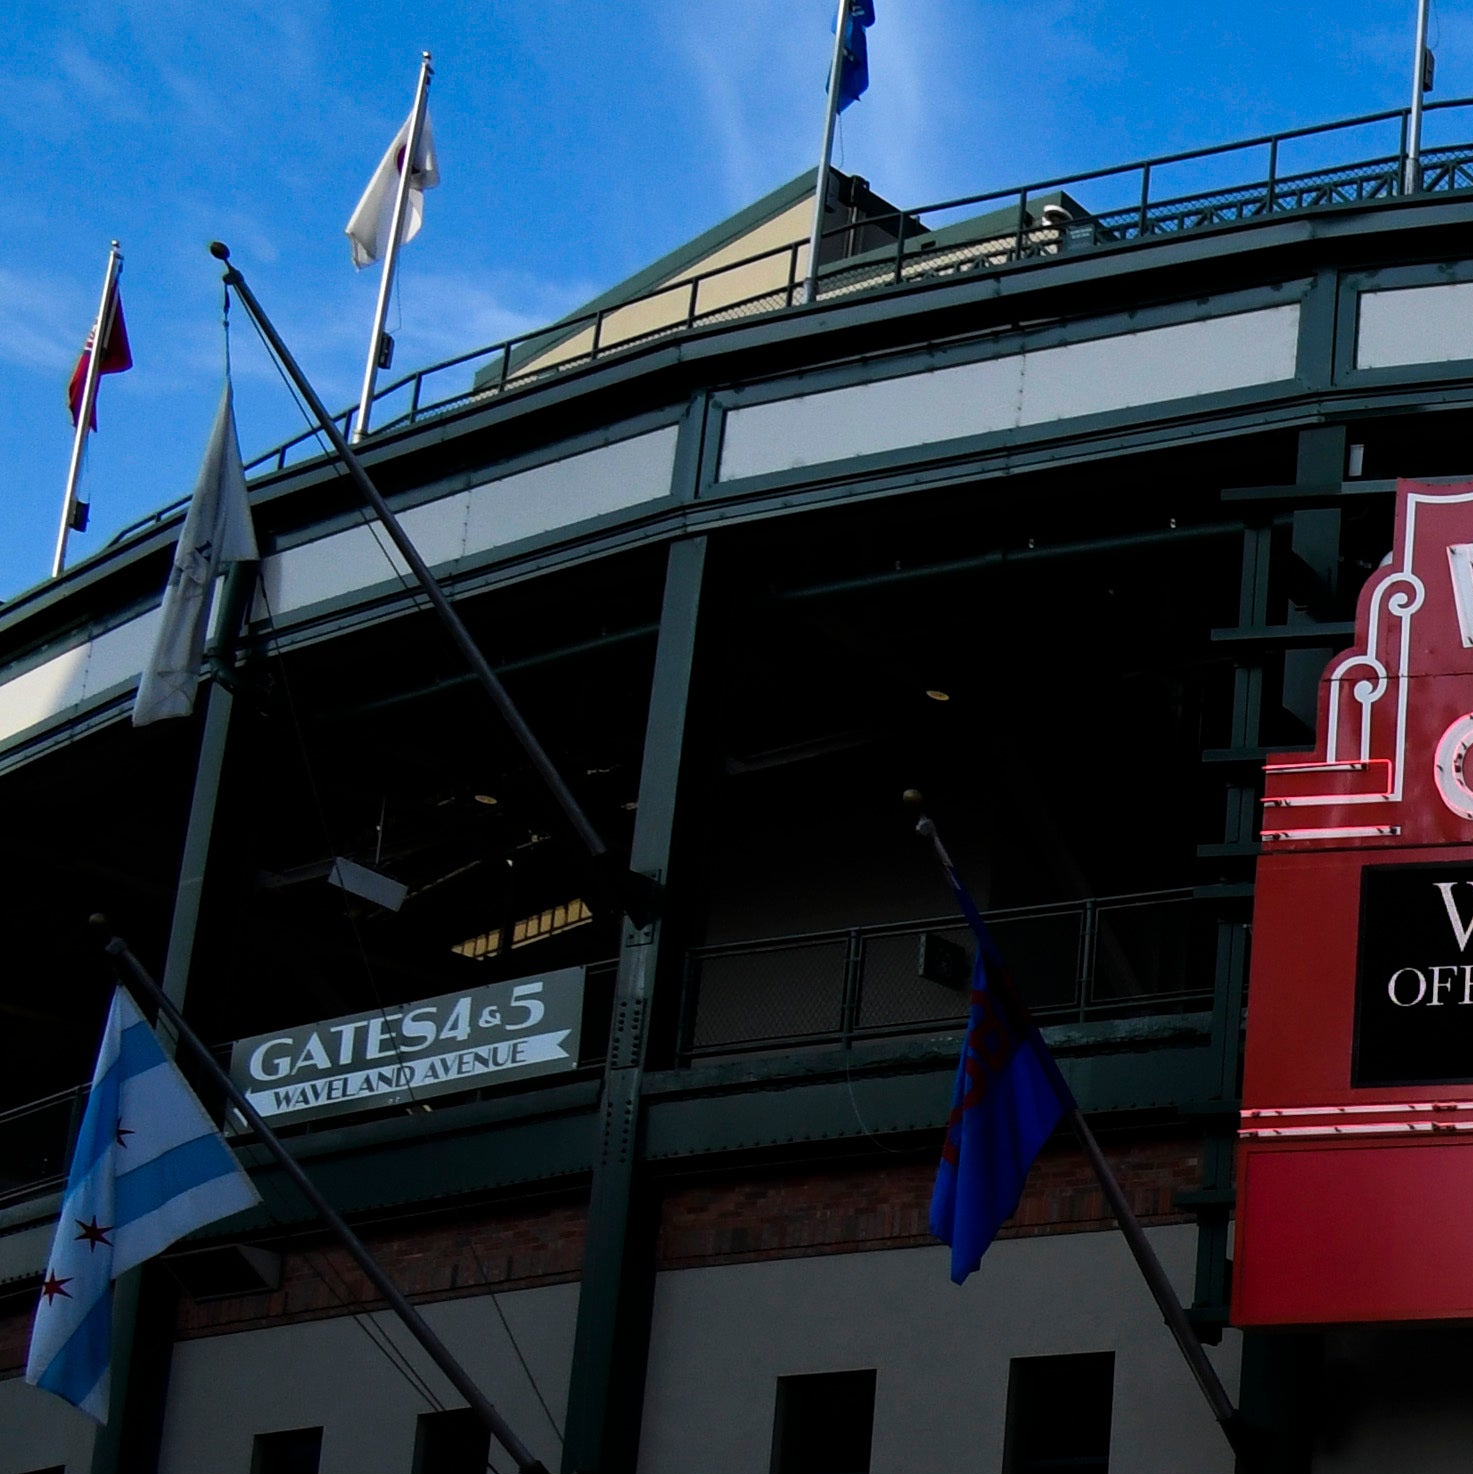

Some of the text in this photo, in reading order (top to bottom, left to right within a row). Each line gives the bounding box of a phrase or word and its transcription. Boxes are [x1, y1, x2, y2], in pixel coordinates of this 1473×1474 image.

[249, 1006, 438, 1082] GATES
[273, 1041, 529, 1111] WAVELAND AVENUE
